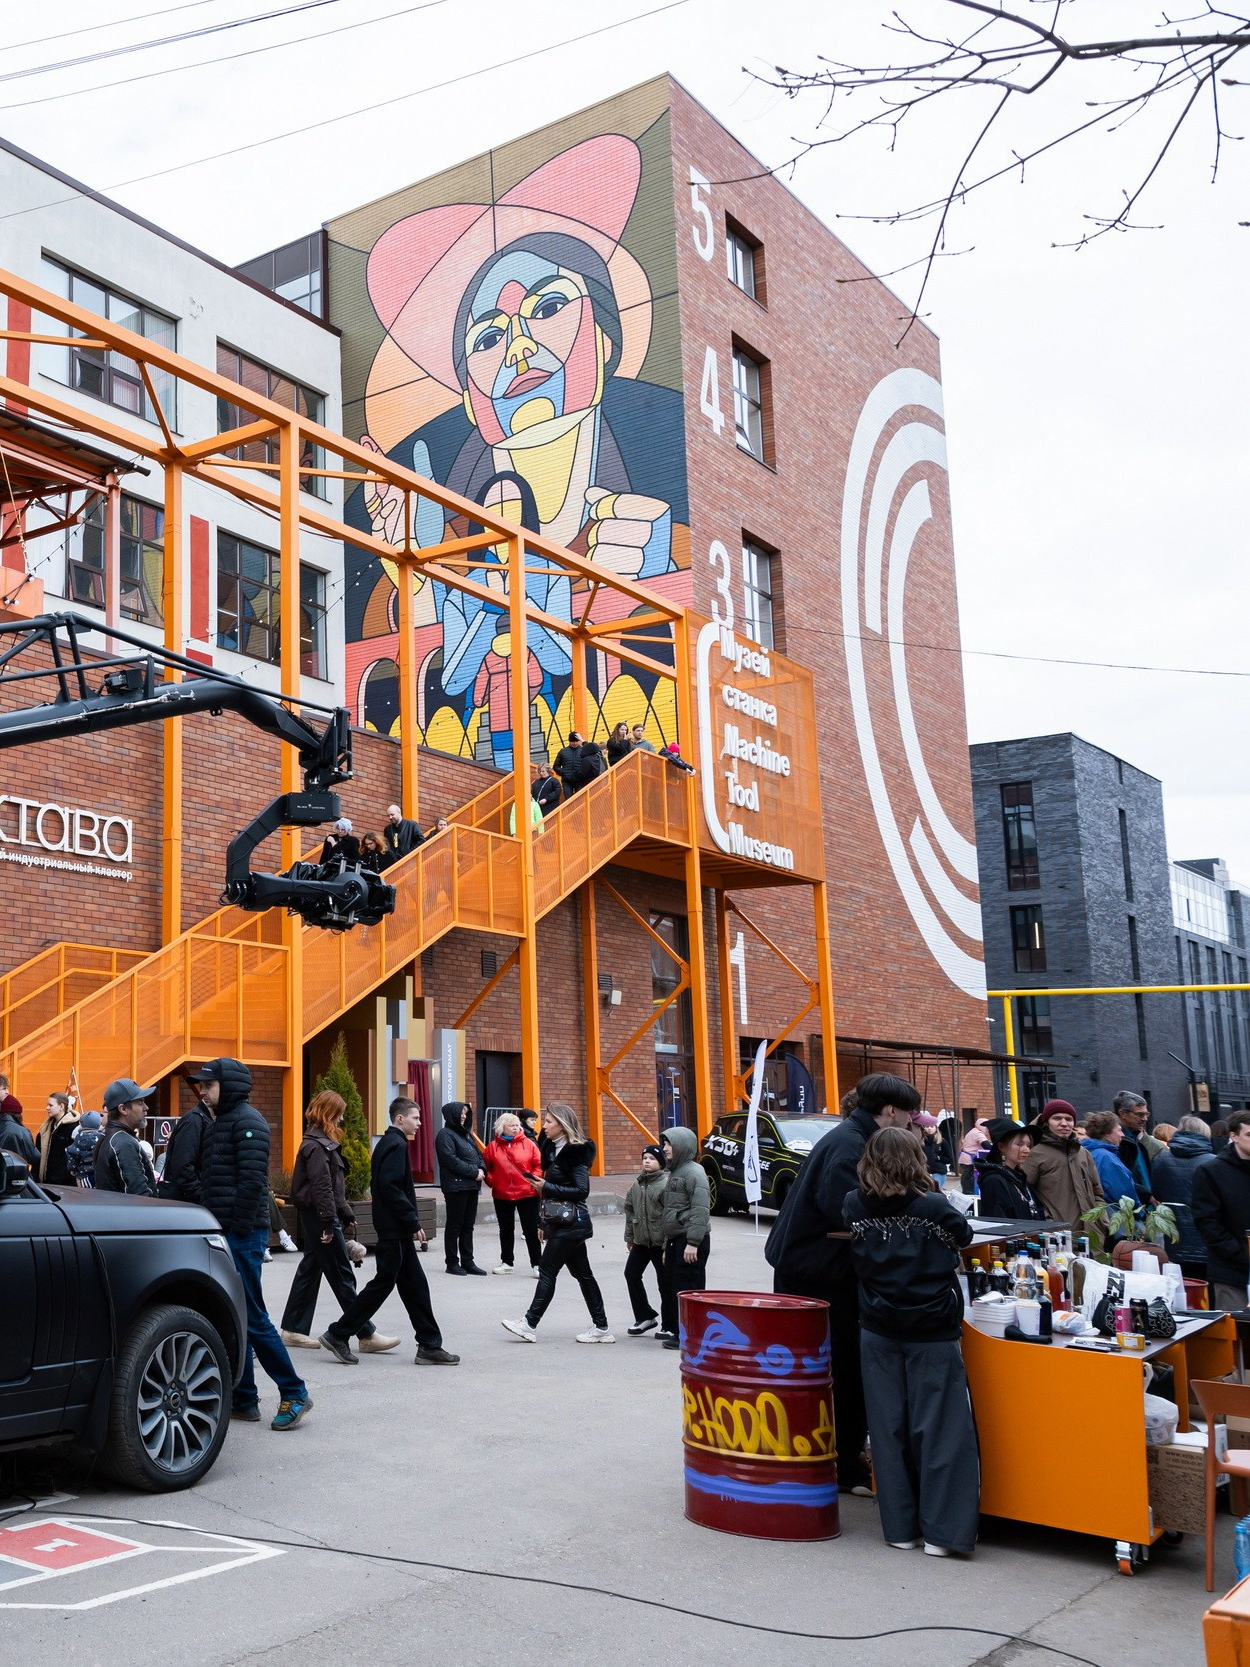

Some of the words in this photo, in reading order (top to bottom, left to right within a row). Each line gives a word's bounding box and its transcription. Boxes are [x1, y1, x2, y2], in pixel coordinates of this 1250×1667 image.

[689, 164, 714, 262] 5
[701, 345, 725, 436] 4
[709, 539, 734, 631] 3
[720, 624, 771, 678] Музей
[722, 684, 777, 726] станка
[723, 723, 790, 777] Machine
[724, 771, 759, 812] Tool
[8, 852, 93, 873] индустриальный
[94, 866, 133, 881] кластер
[728, 821, 794, 870] Museum
[729, 931, 748, 1025] 1
[33, 1537, 79, 1553] 1
